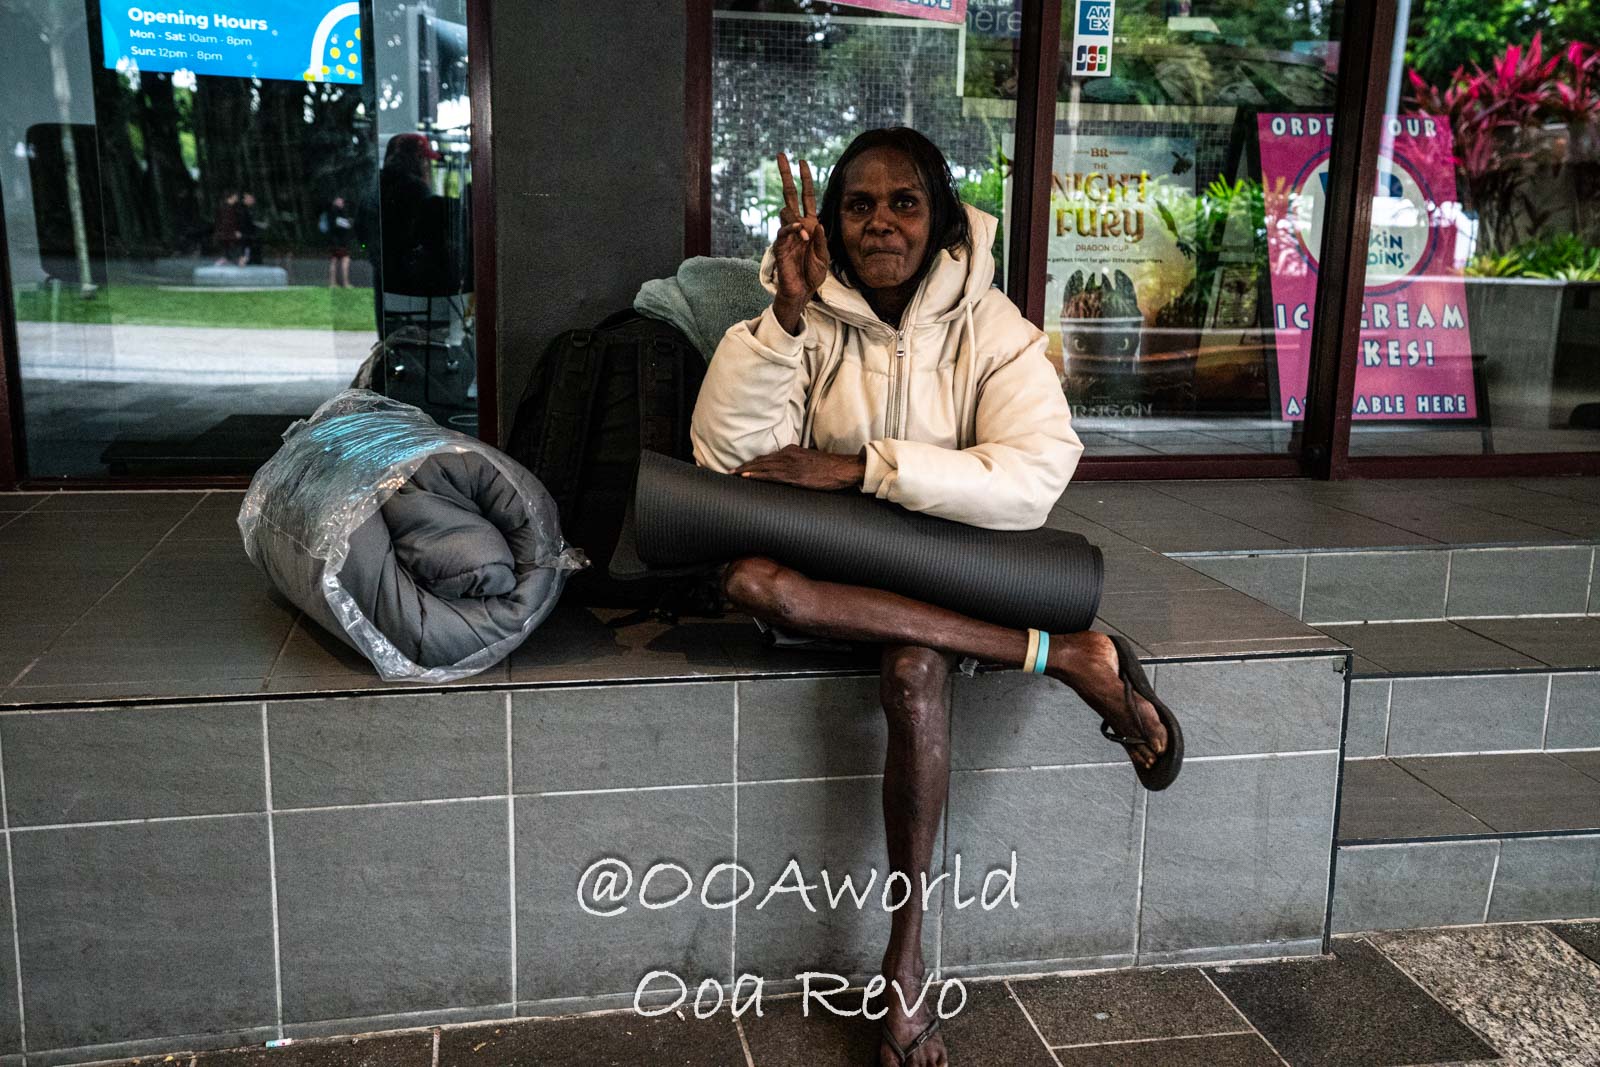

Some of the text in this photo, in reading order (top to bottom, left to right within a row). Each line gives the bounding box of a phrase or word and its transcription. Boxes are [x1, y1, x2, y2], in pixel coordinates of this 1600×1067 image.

[128, 7, 268, 31] Opening Hours
[129, 29, 155, 39] Mon
[165, 31, 186, 42] Sat:
[189, 33, 217, 44] 10am
[226, 36, 252, 47] 8pm
[131, 46, 156, 57] Sun:
[158, 48, 187, 59] 12pm
[197, 51, 223, 61] 8pm
[1271, 116, 1437, 137] ORDE OUR
[1051, 172, 1152, 203] NIGHT
[1075, 244, 1110, 252] DRAGON
[1276, 303, 1310, 330] IC
[1362, 340, 1435, 367] KES!
[1416, 395, 1467, 414] HERE
